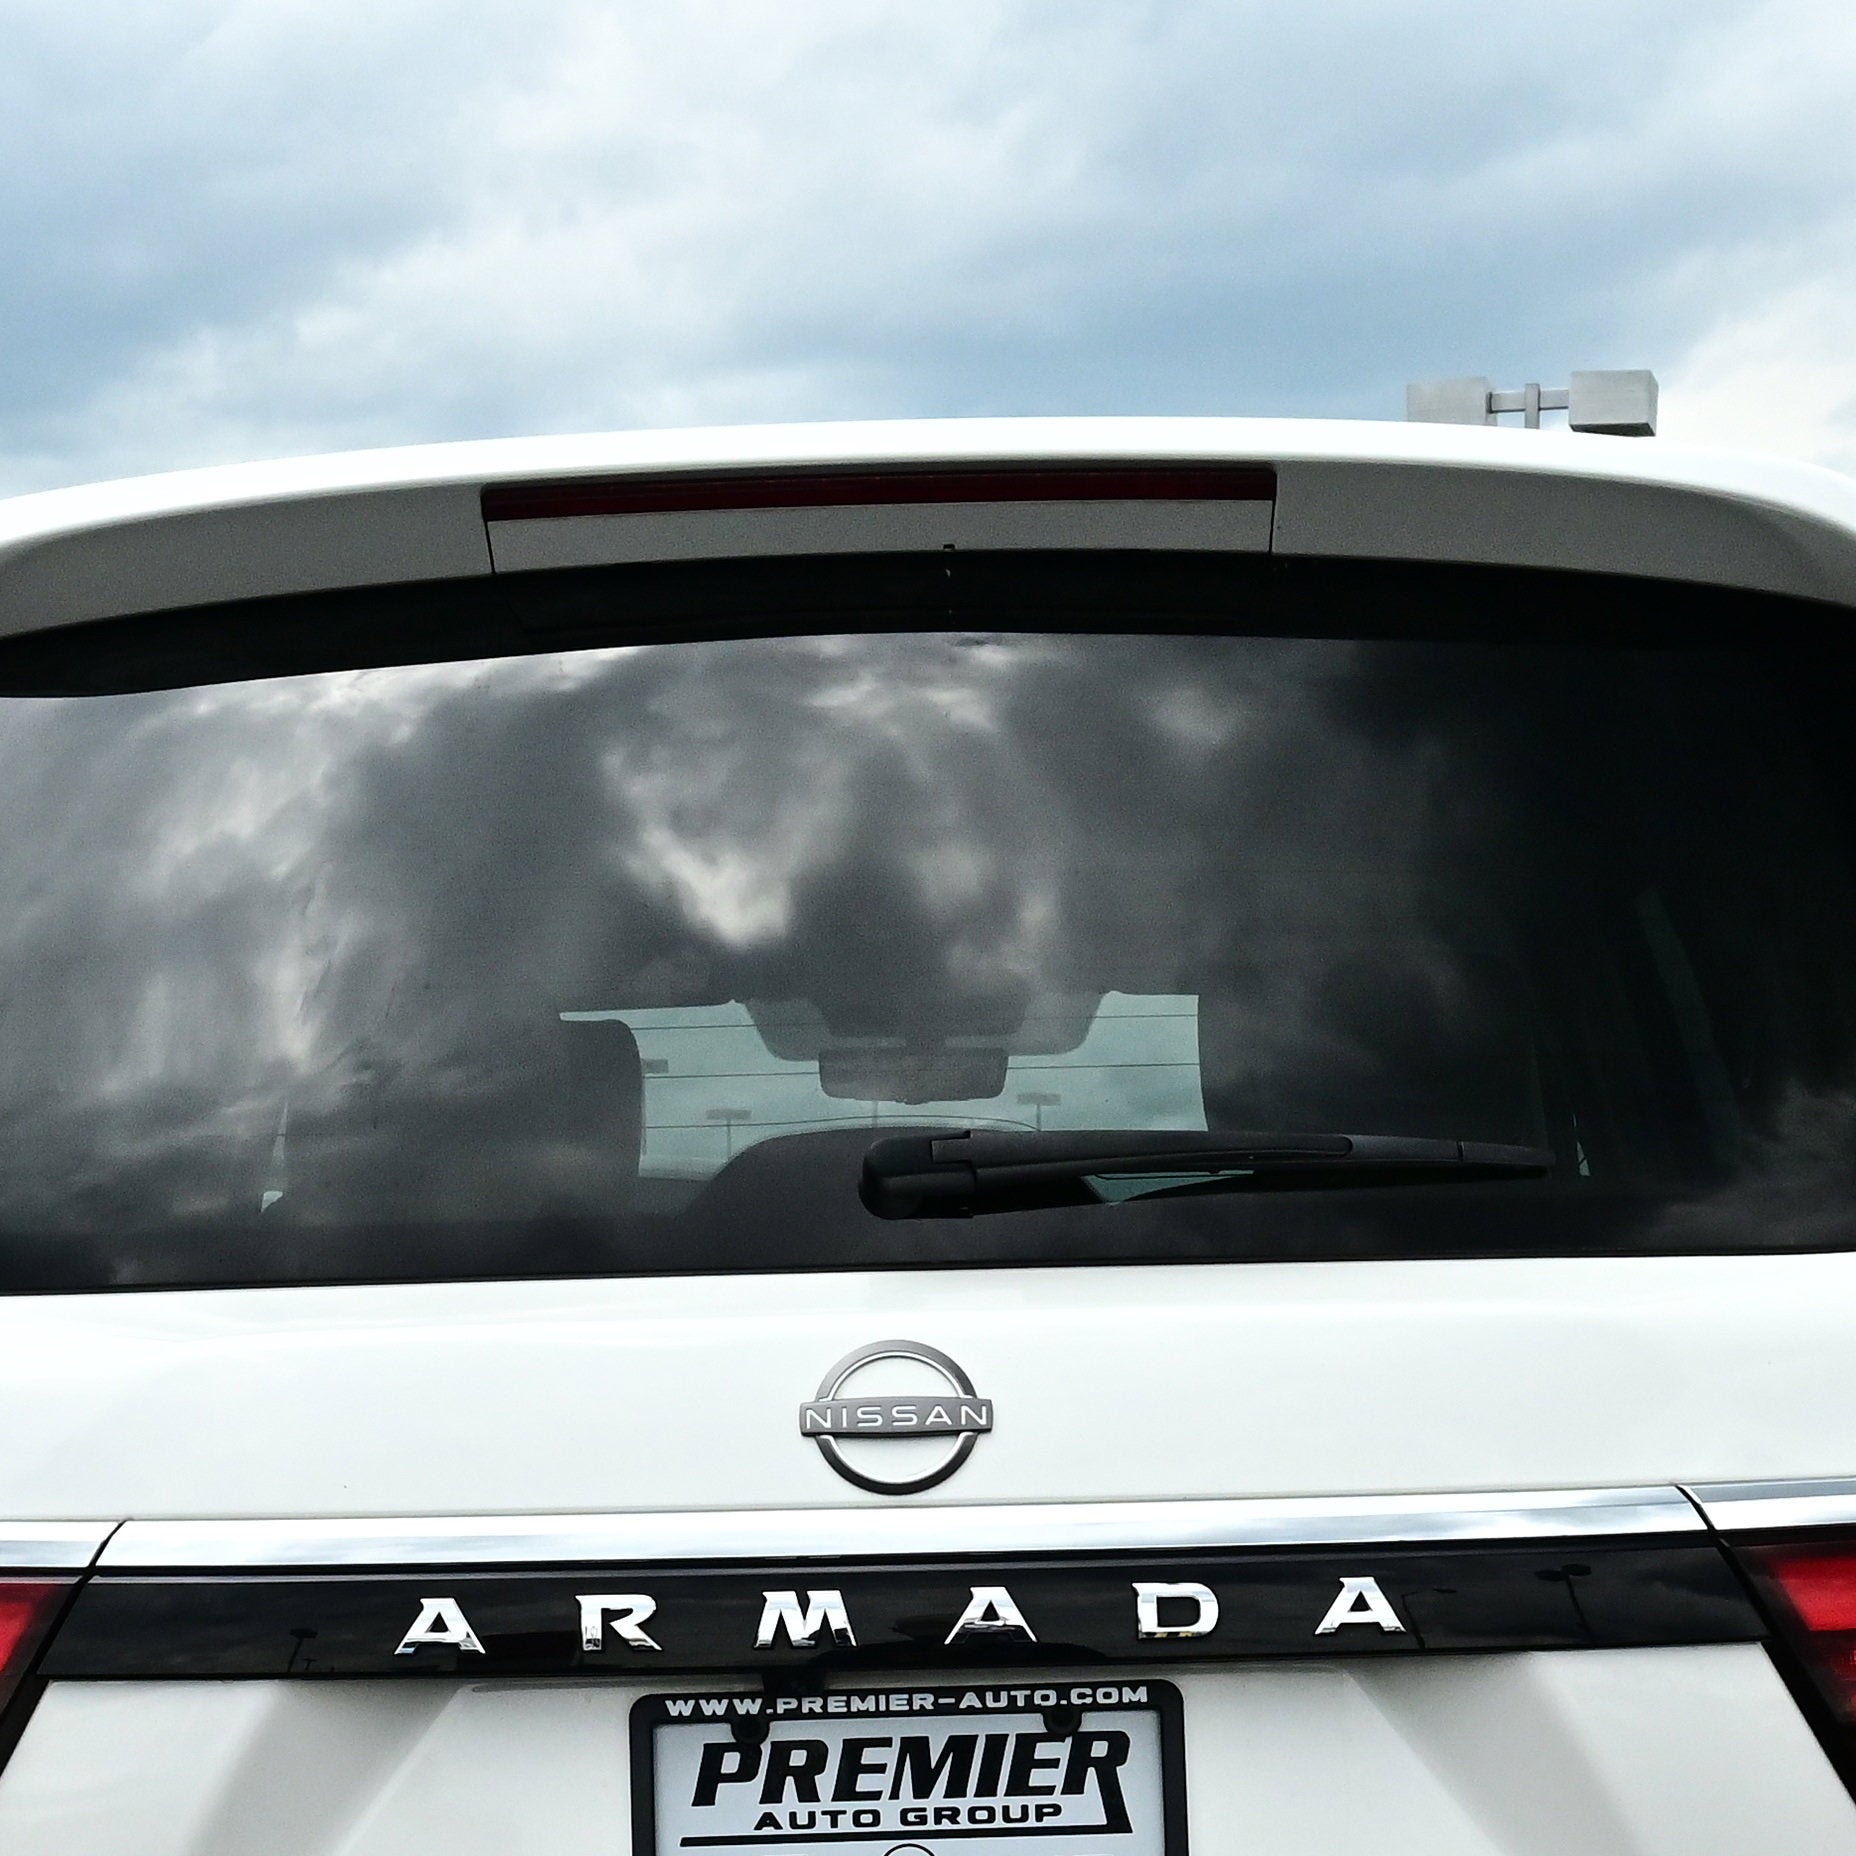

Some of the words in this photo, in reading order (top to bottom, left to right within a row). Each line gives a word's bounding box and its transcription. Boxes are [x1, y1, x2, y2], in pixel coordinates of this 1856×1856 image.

[805, 1404, 987, 1429] NISSAN
[394, 1576, 1400, 1655] ARMADA
[664, 1686, 1148, 1717] WWW.PREMIER-AUTO.COM
[691, 1729, 1133, 1815] PREMIER
[753, 1808, 879, 1831] AUTO
[899, 1803, 1063, 1827] GROUP
